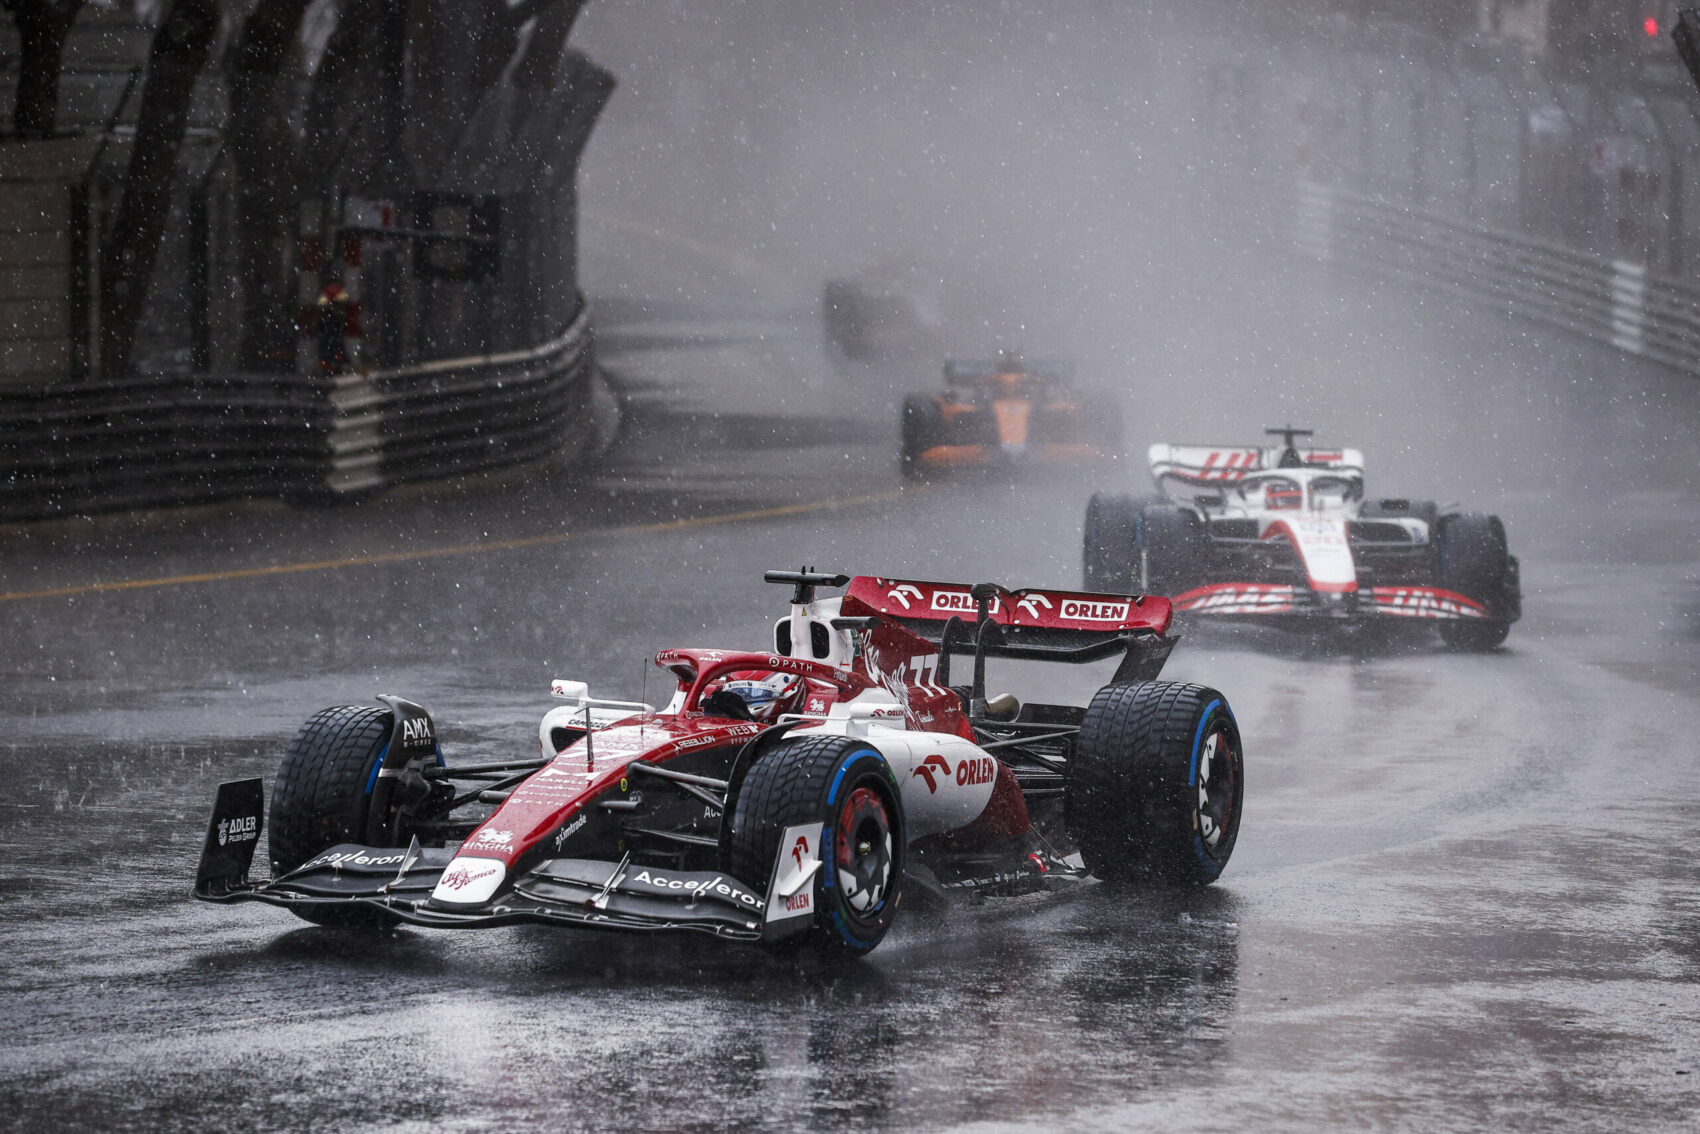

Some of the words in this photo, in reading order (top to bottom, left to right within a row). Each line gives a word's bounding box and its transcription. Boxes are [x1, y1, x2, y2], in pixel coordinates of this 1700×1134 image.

[1064, 602, 1126, 619] ORLEN
[783, 659, 813, 671] PATH
[910, 653, 947, 697] 77
[403, 717, 431, 741] AMX
[678, 735, 716, 748] REBELLION
[534, 777, 590, 786] MARELLI
[956, 758, 994, 787] ORLEN
[229, 816, 256, 834] ADLER
[462, 841, 514, 855] SINGHA
[454, 868, 497, 891] Romeo
[785, 893, 809, 912] ORLEN
